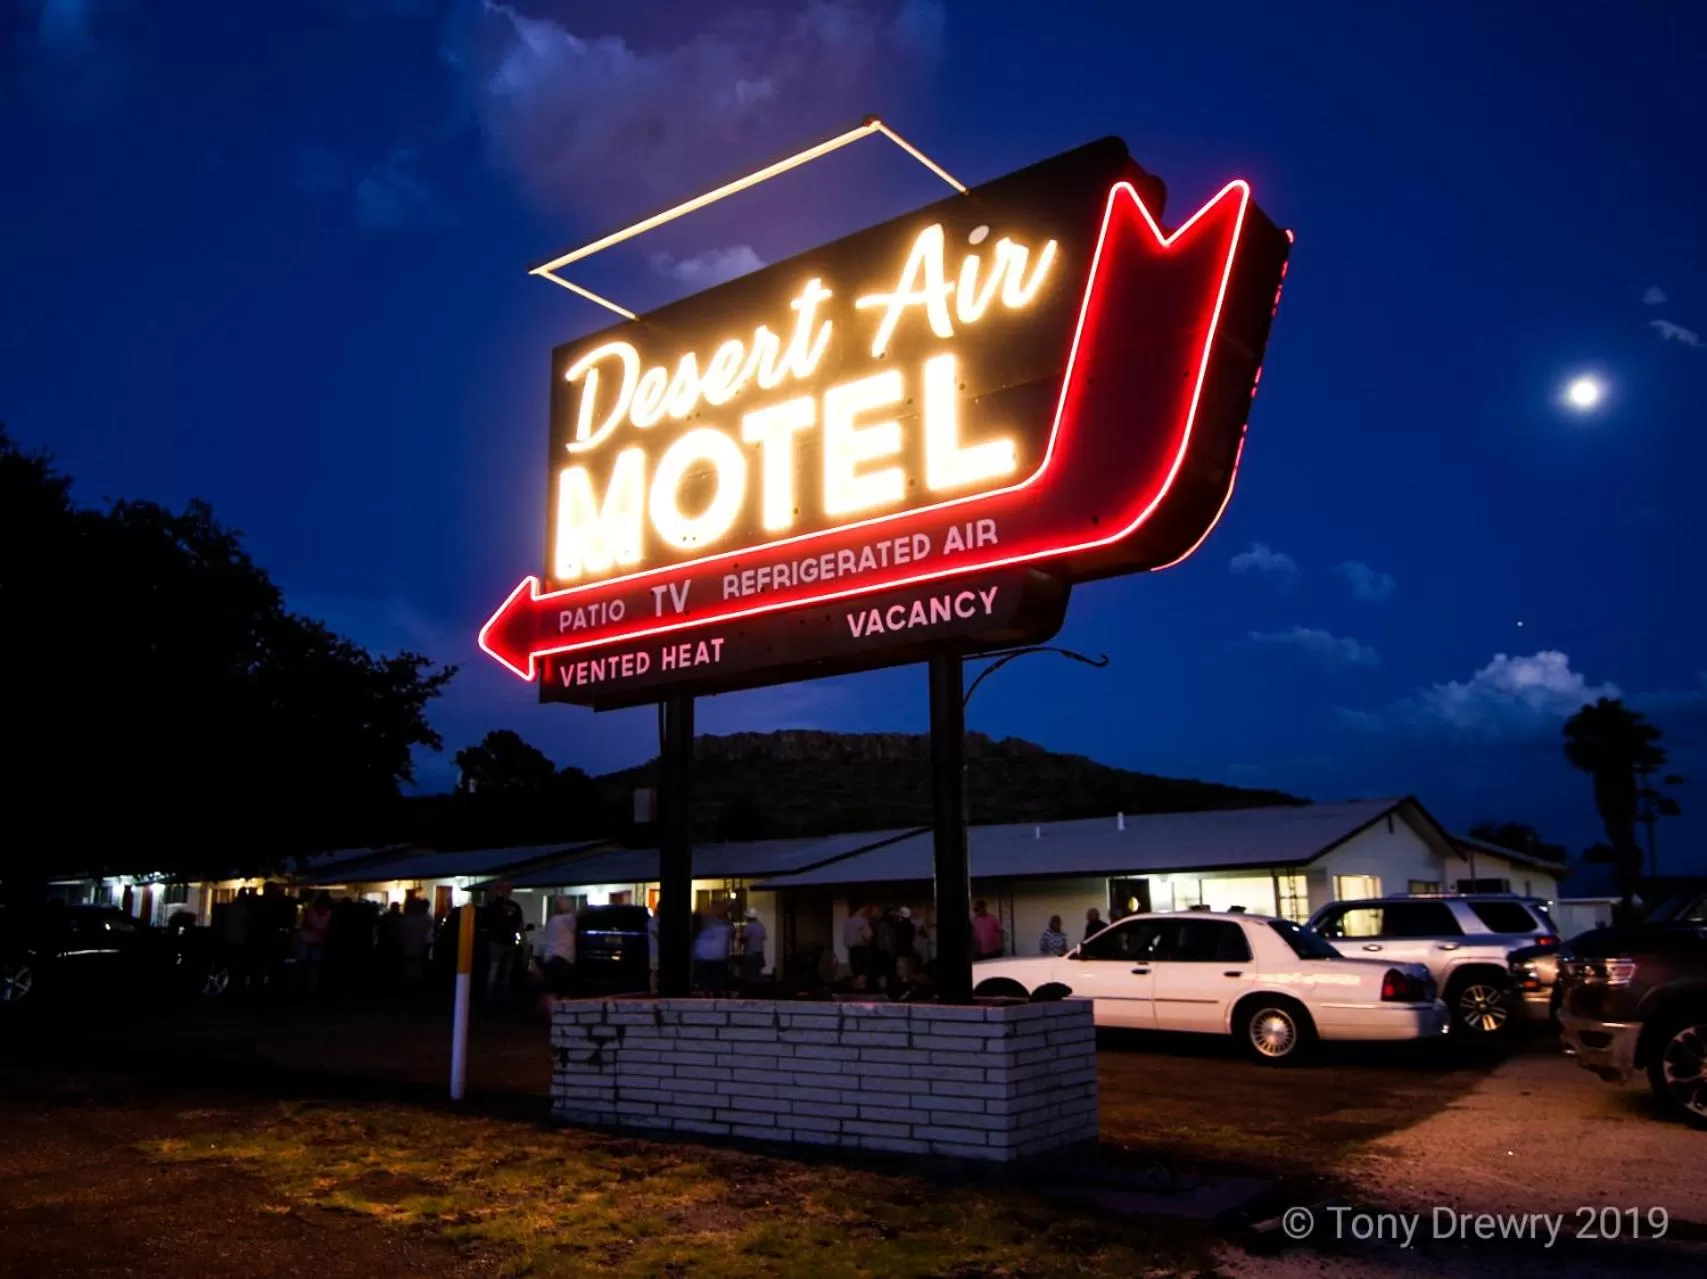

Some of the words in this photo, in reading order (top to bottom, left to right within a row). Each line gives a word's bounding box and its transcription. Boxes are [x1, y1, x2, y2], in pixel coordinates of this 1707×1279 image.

[565, 277, 833, 452] Desert
[855, 223, 1058, 358] Air
[554, 352, 1018, 582] MOTEL
[558, 599, 626, 633] PATIO
[651, 579, 691, 617] TV
[722, 532, 931, 601] REFRIGERATED
[943, 518, 999, 556] AIR
[847, 586, 999, 638] VACANCY
[559, 651, 651, 688] VENTED
[661, 637, 725, 671] HEAT
